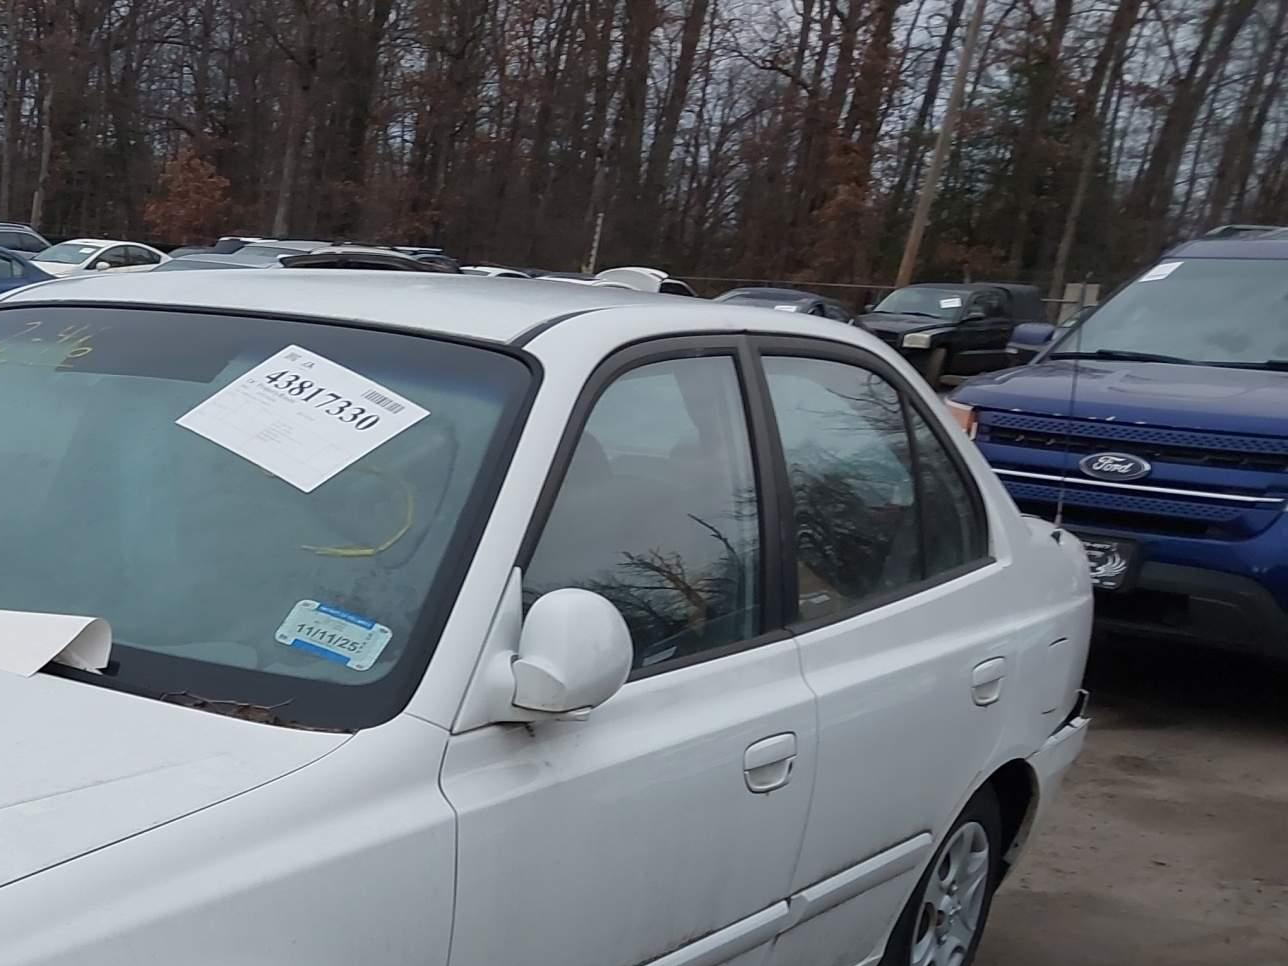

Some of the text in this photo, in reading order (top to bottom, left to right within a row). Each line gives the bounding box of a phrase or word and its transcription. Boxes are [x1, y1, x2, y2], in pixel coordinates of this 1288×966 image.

[265, 369, 381, 431] 43817330
[1092, 455, 1134, 474] Ford
[296, 623, 358, 652] 11/11/25
